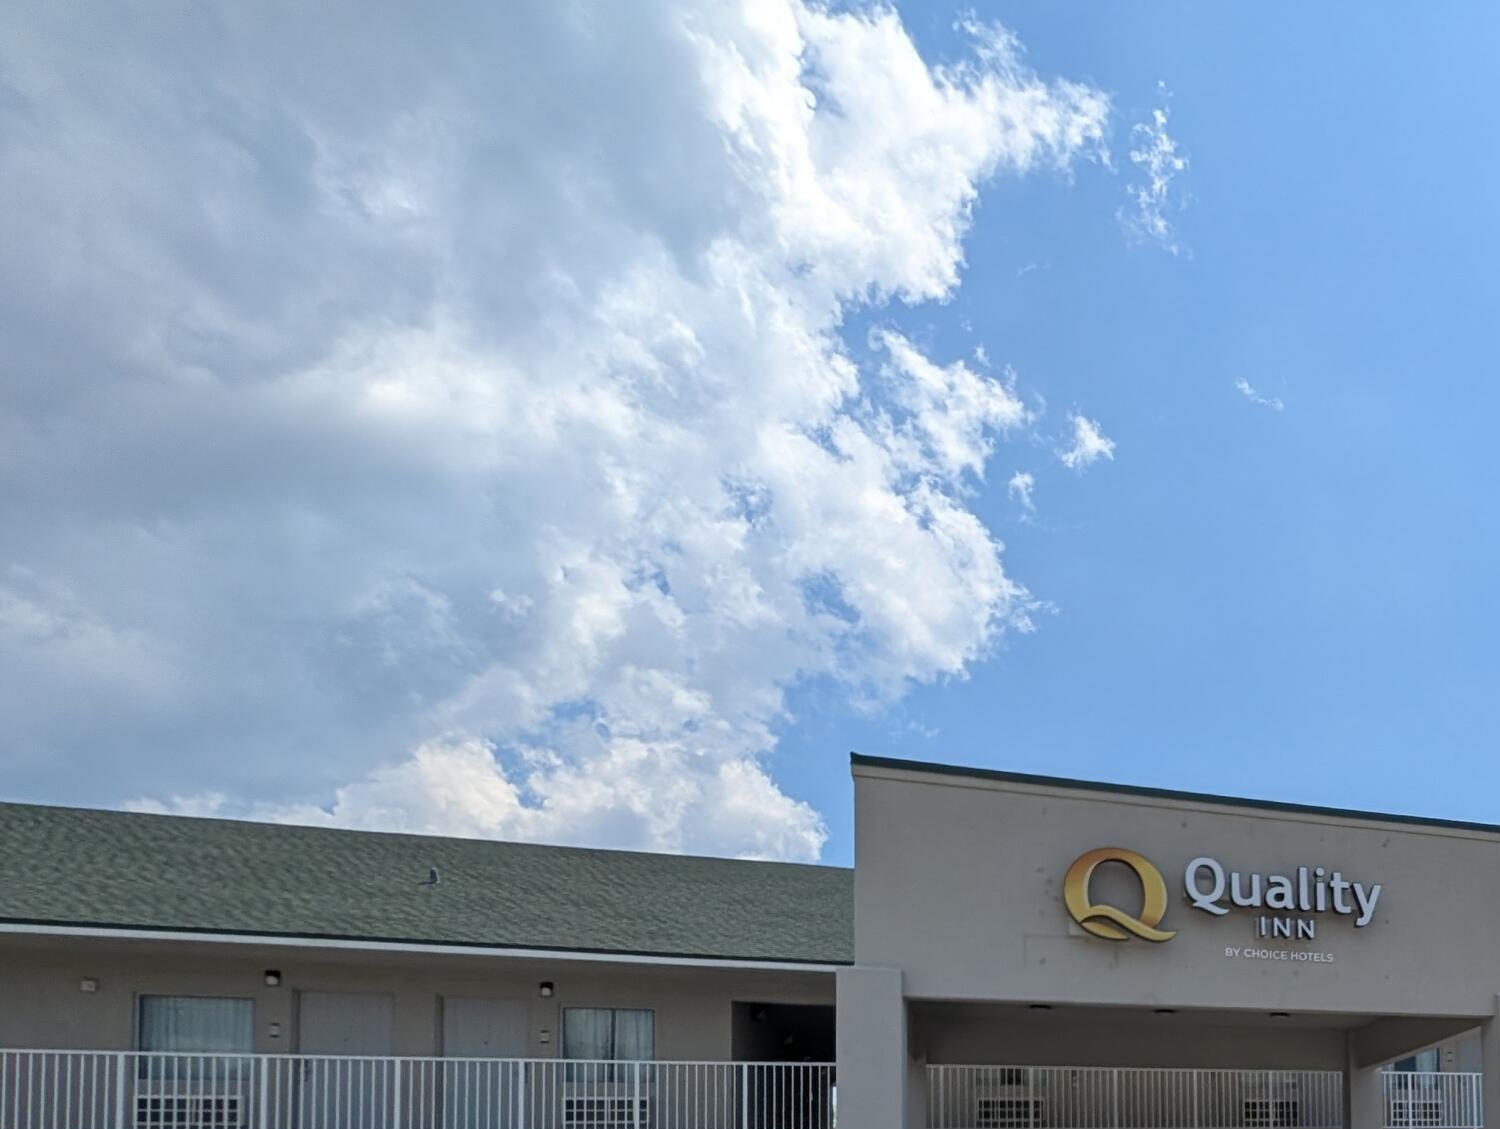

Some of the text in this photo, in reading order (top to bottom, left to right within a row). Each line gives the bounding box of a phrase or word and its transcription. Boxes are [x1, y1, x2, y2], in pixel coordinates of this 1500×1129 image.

[1184, 857, 1382, 927] Quality
[1256, 916, 1316, 940] INN
[1224, 947, 1334, 963] BY CHOICE HOTELS
